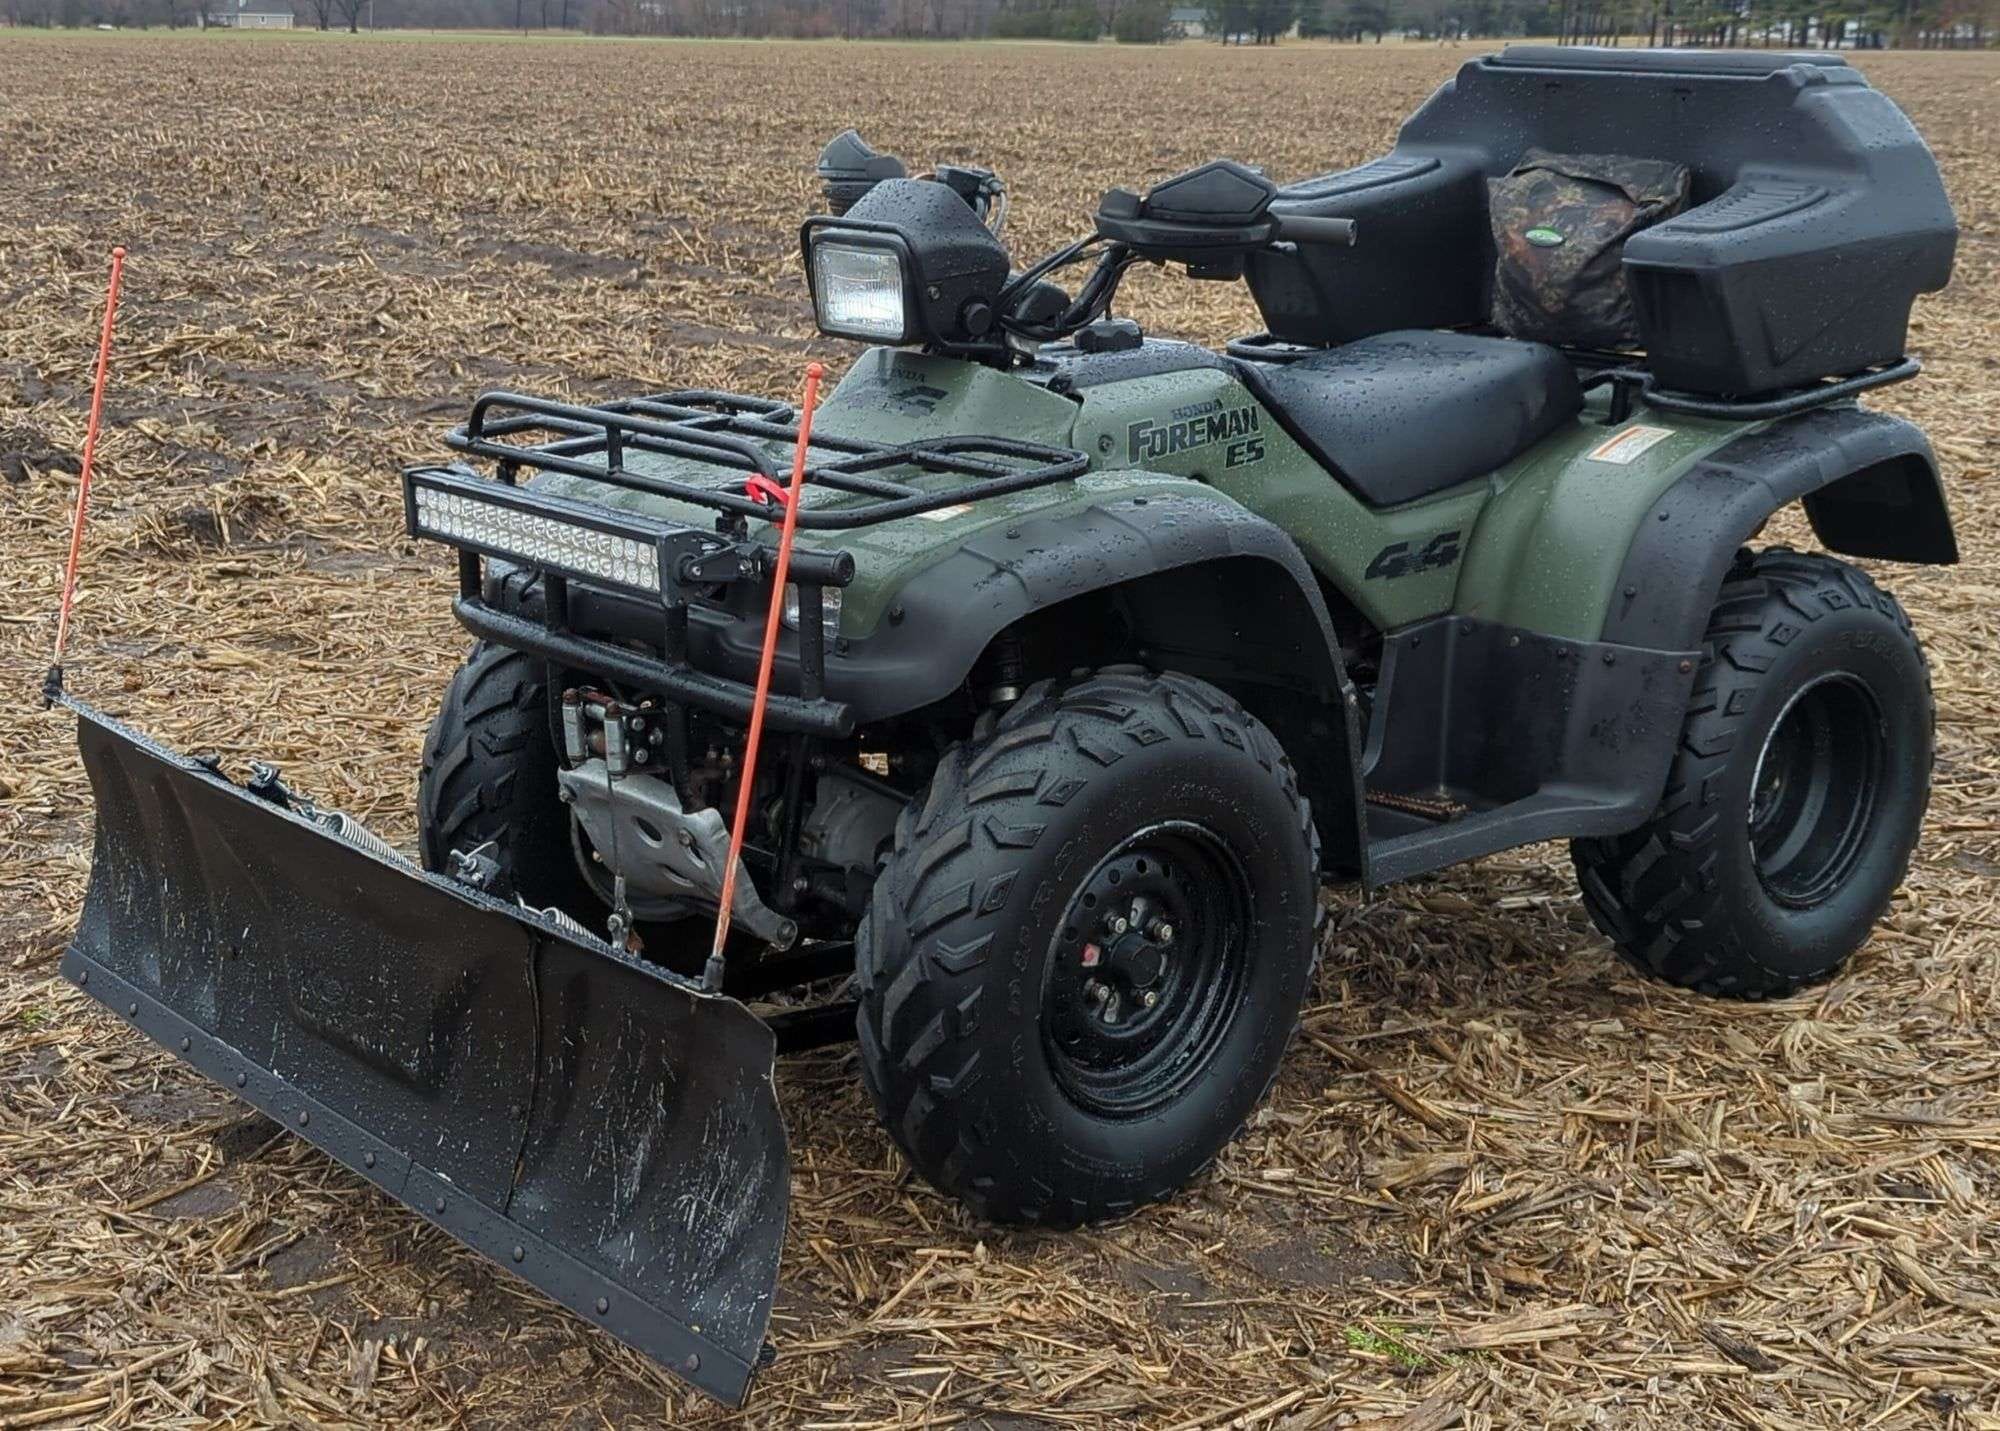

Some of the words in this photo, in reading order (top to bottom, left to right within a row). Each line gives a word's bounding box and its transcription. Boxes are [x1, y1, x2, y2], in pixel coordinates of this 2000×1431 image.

[1171, 398, 1224, 420] HONDA
[1127, 404, 1260, 465] FOREMAN
[1225, 436, 1265, 469] ES
